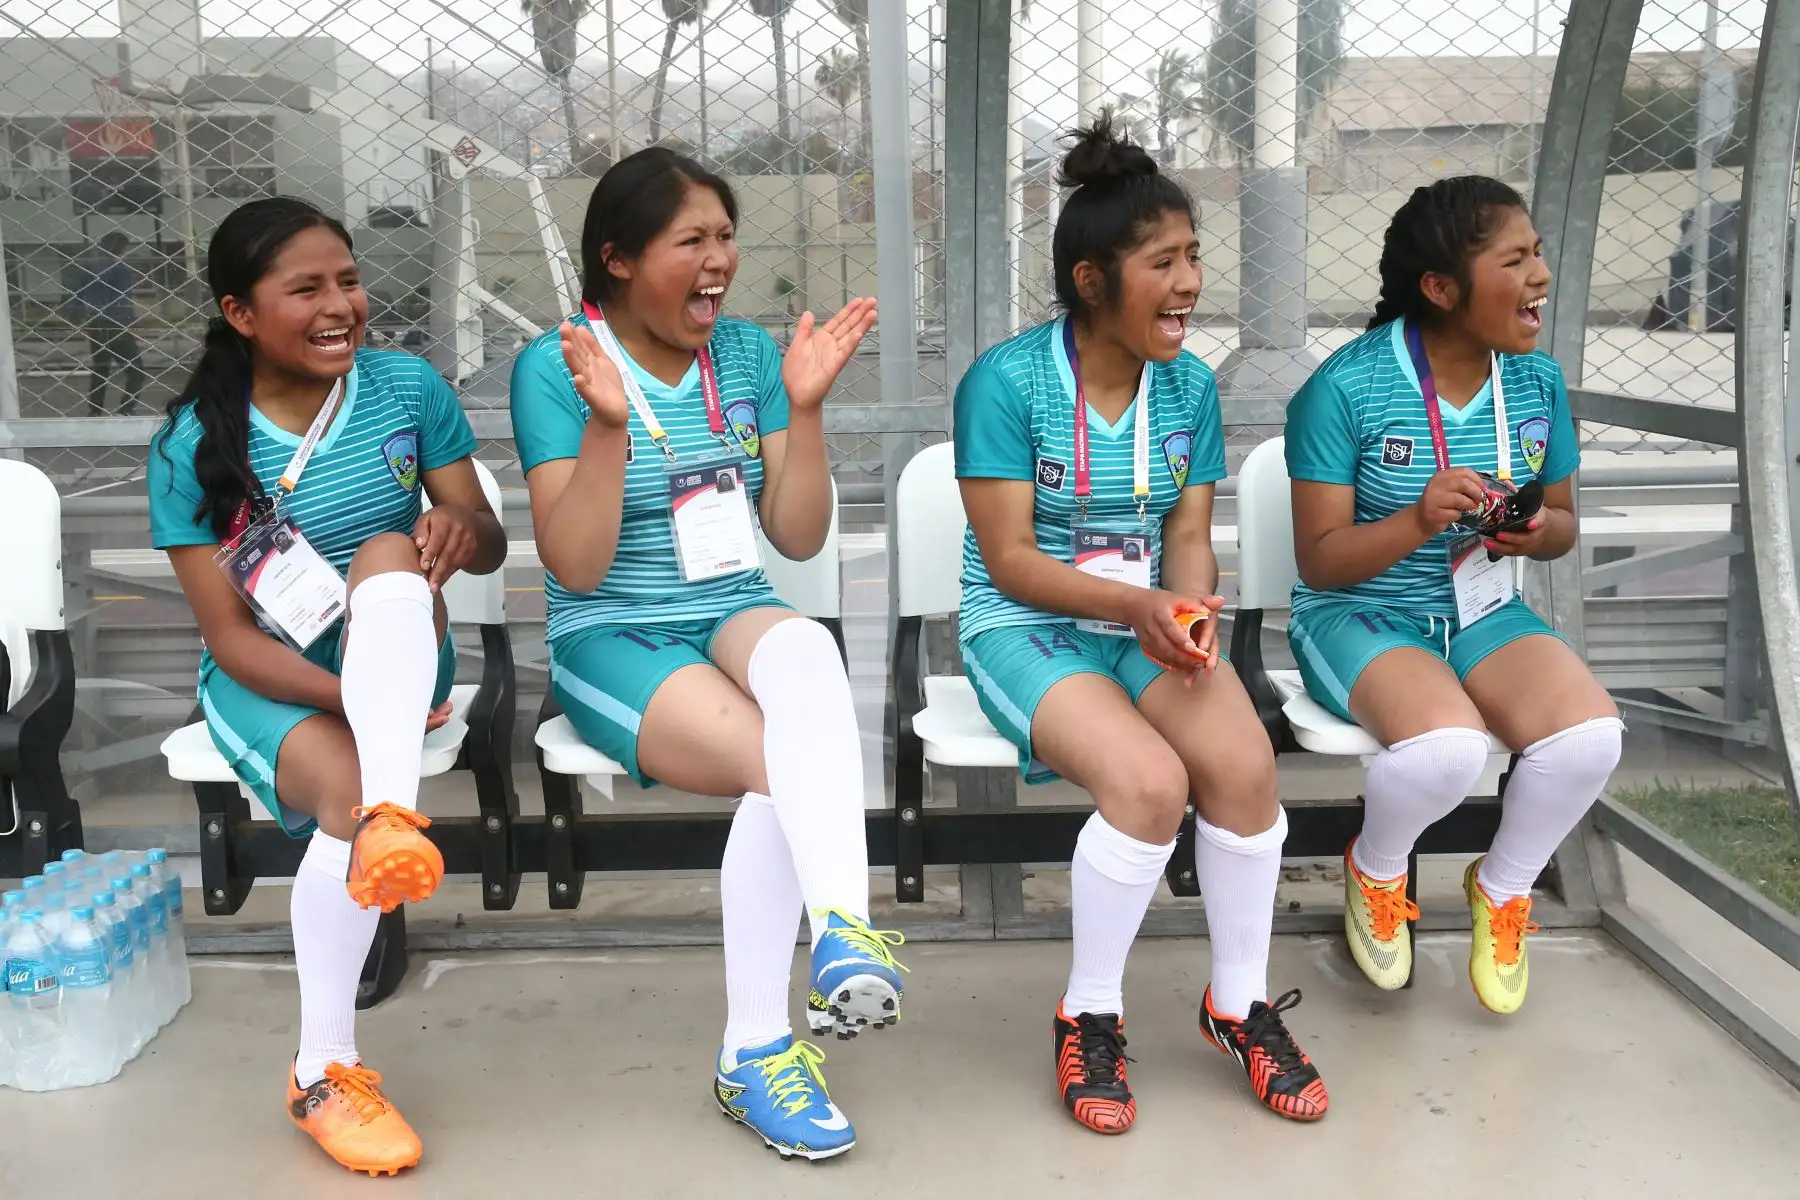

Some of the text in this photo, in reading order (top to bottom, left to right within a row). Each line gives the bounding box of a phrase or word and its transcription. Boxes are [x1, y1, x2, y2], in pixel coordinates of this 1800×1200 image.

[703, 367, 713, 393] NACIONAL
[707, 393, 715, 411] ETAPA
[1027, 631, 1082, 660] 14
